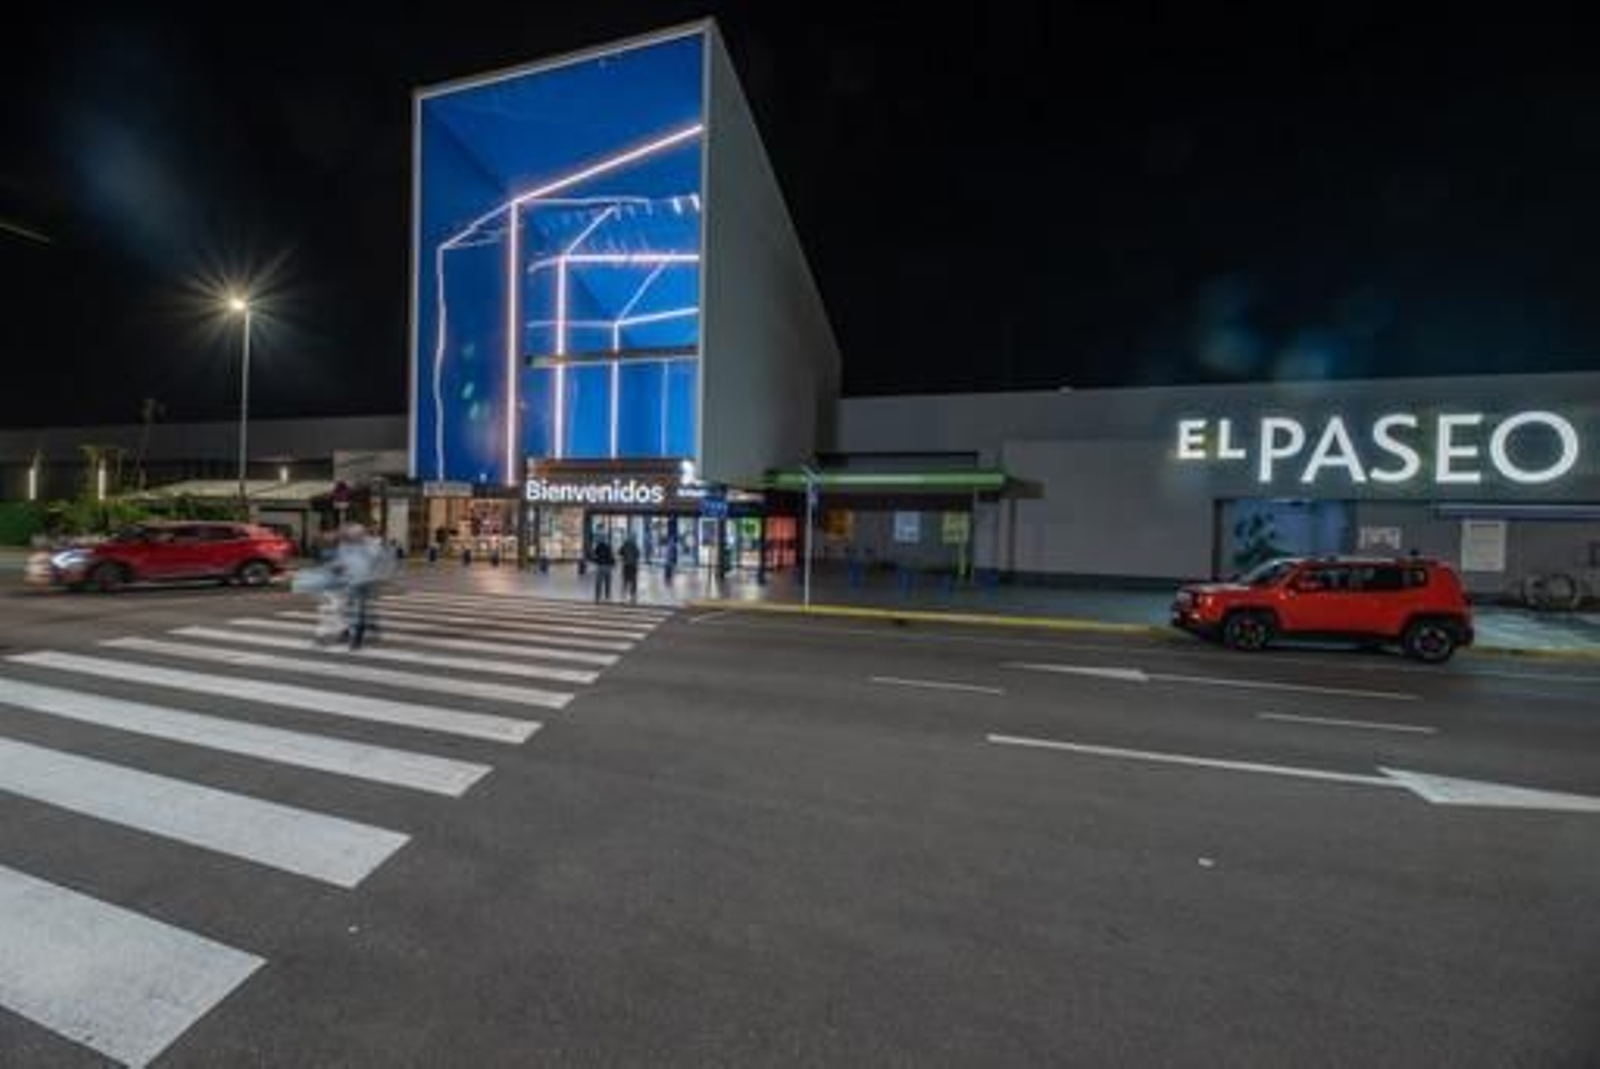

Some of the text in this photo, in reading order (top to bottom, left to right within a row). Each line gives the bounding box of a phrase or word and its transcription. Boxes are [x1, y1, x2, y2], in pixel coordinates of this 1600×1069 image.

[1177, 410, 1579, 484] EL PASEO
[525, 479, 664, 503] Bienvenidos
